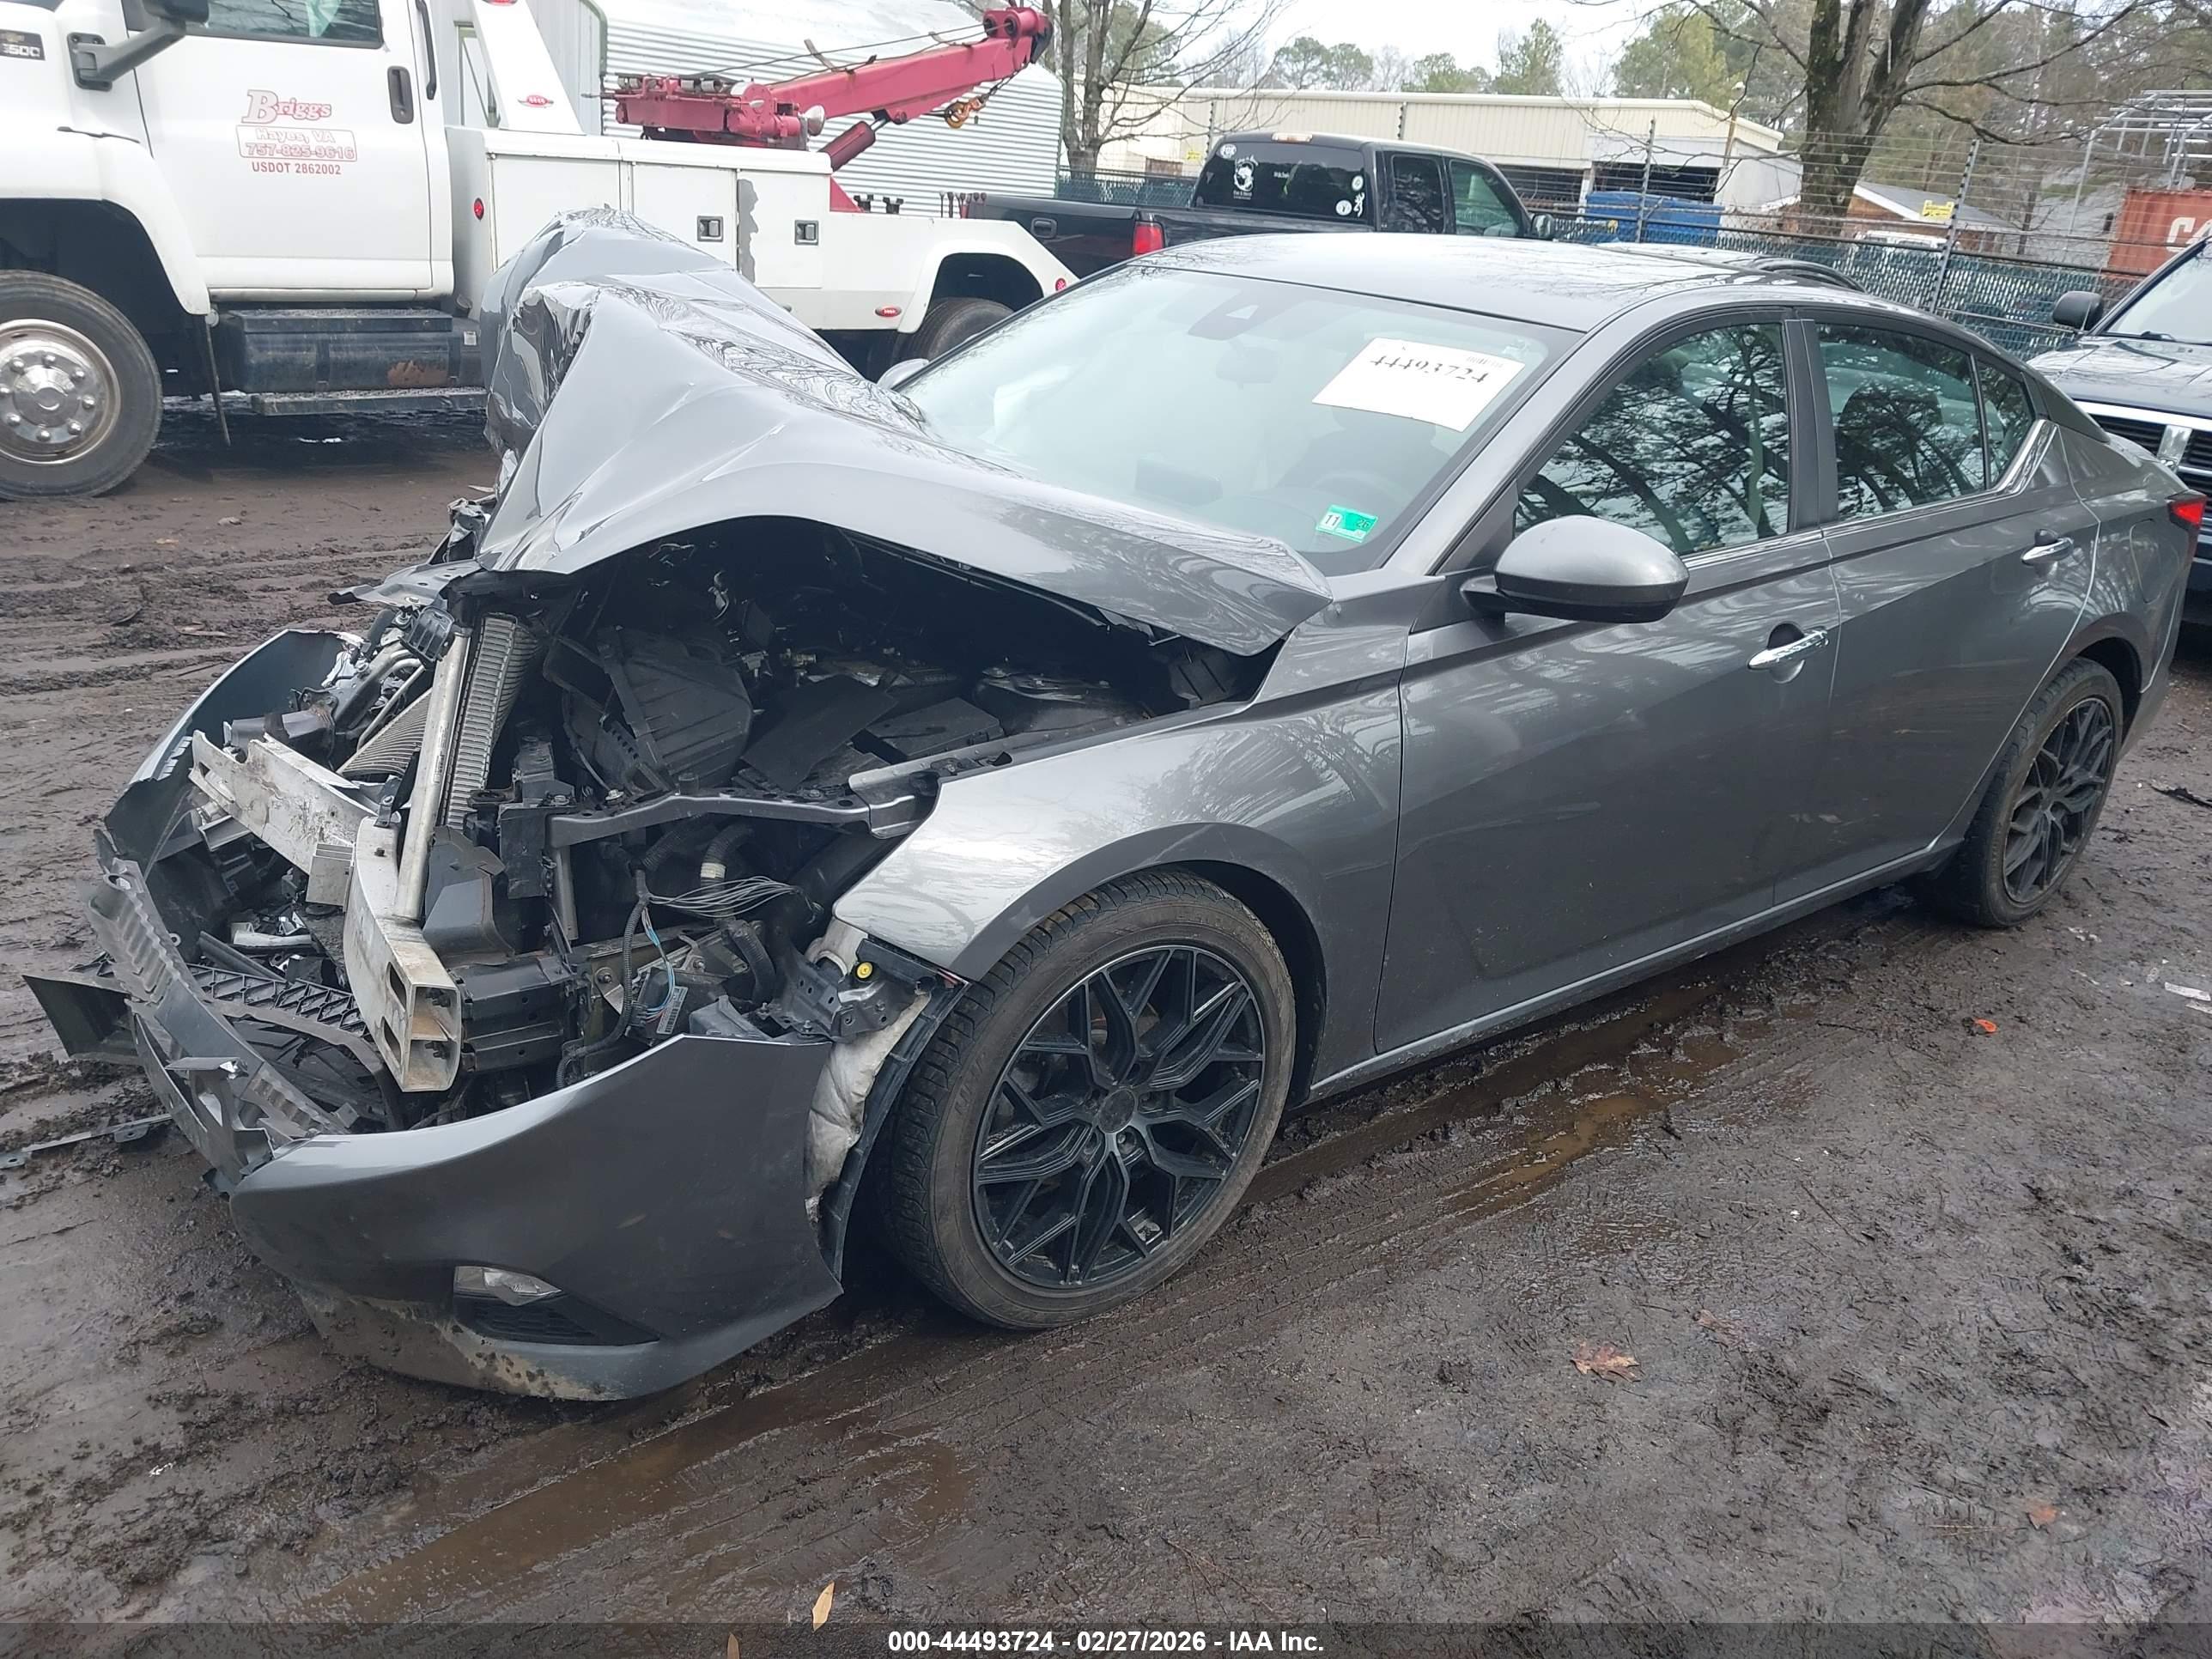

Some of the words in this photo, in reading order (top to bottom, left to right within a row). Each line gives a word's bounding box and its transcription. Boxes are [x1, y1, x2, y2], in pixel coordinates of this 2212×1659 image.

[241, 89, 331, 124] Briggs
[252, 161, 290, 173] USDOT
[295, 163, 342, 175] 2862002
[1370, 355, 1489, 383] 44493724
